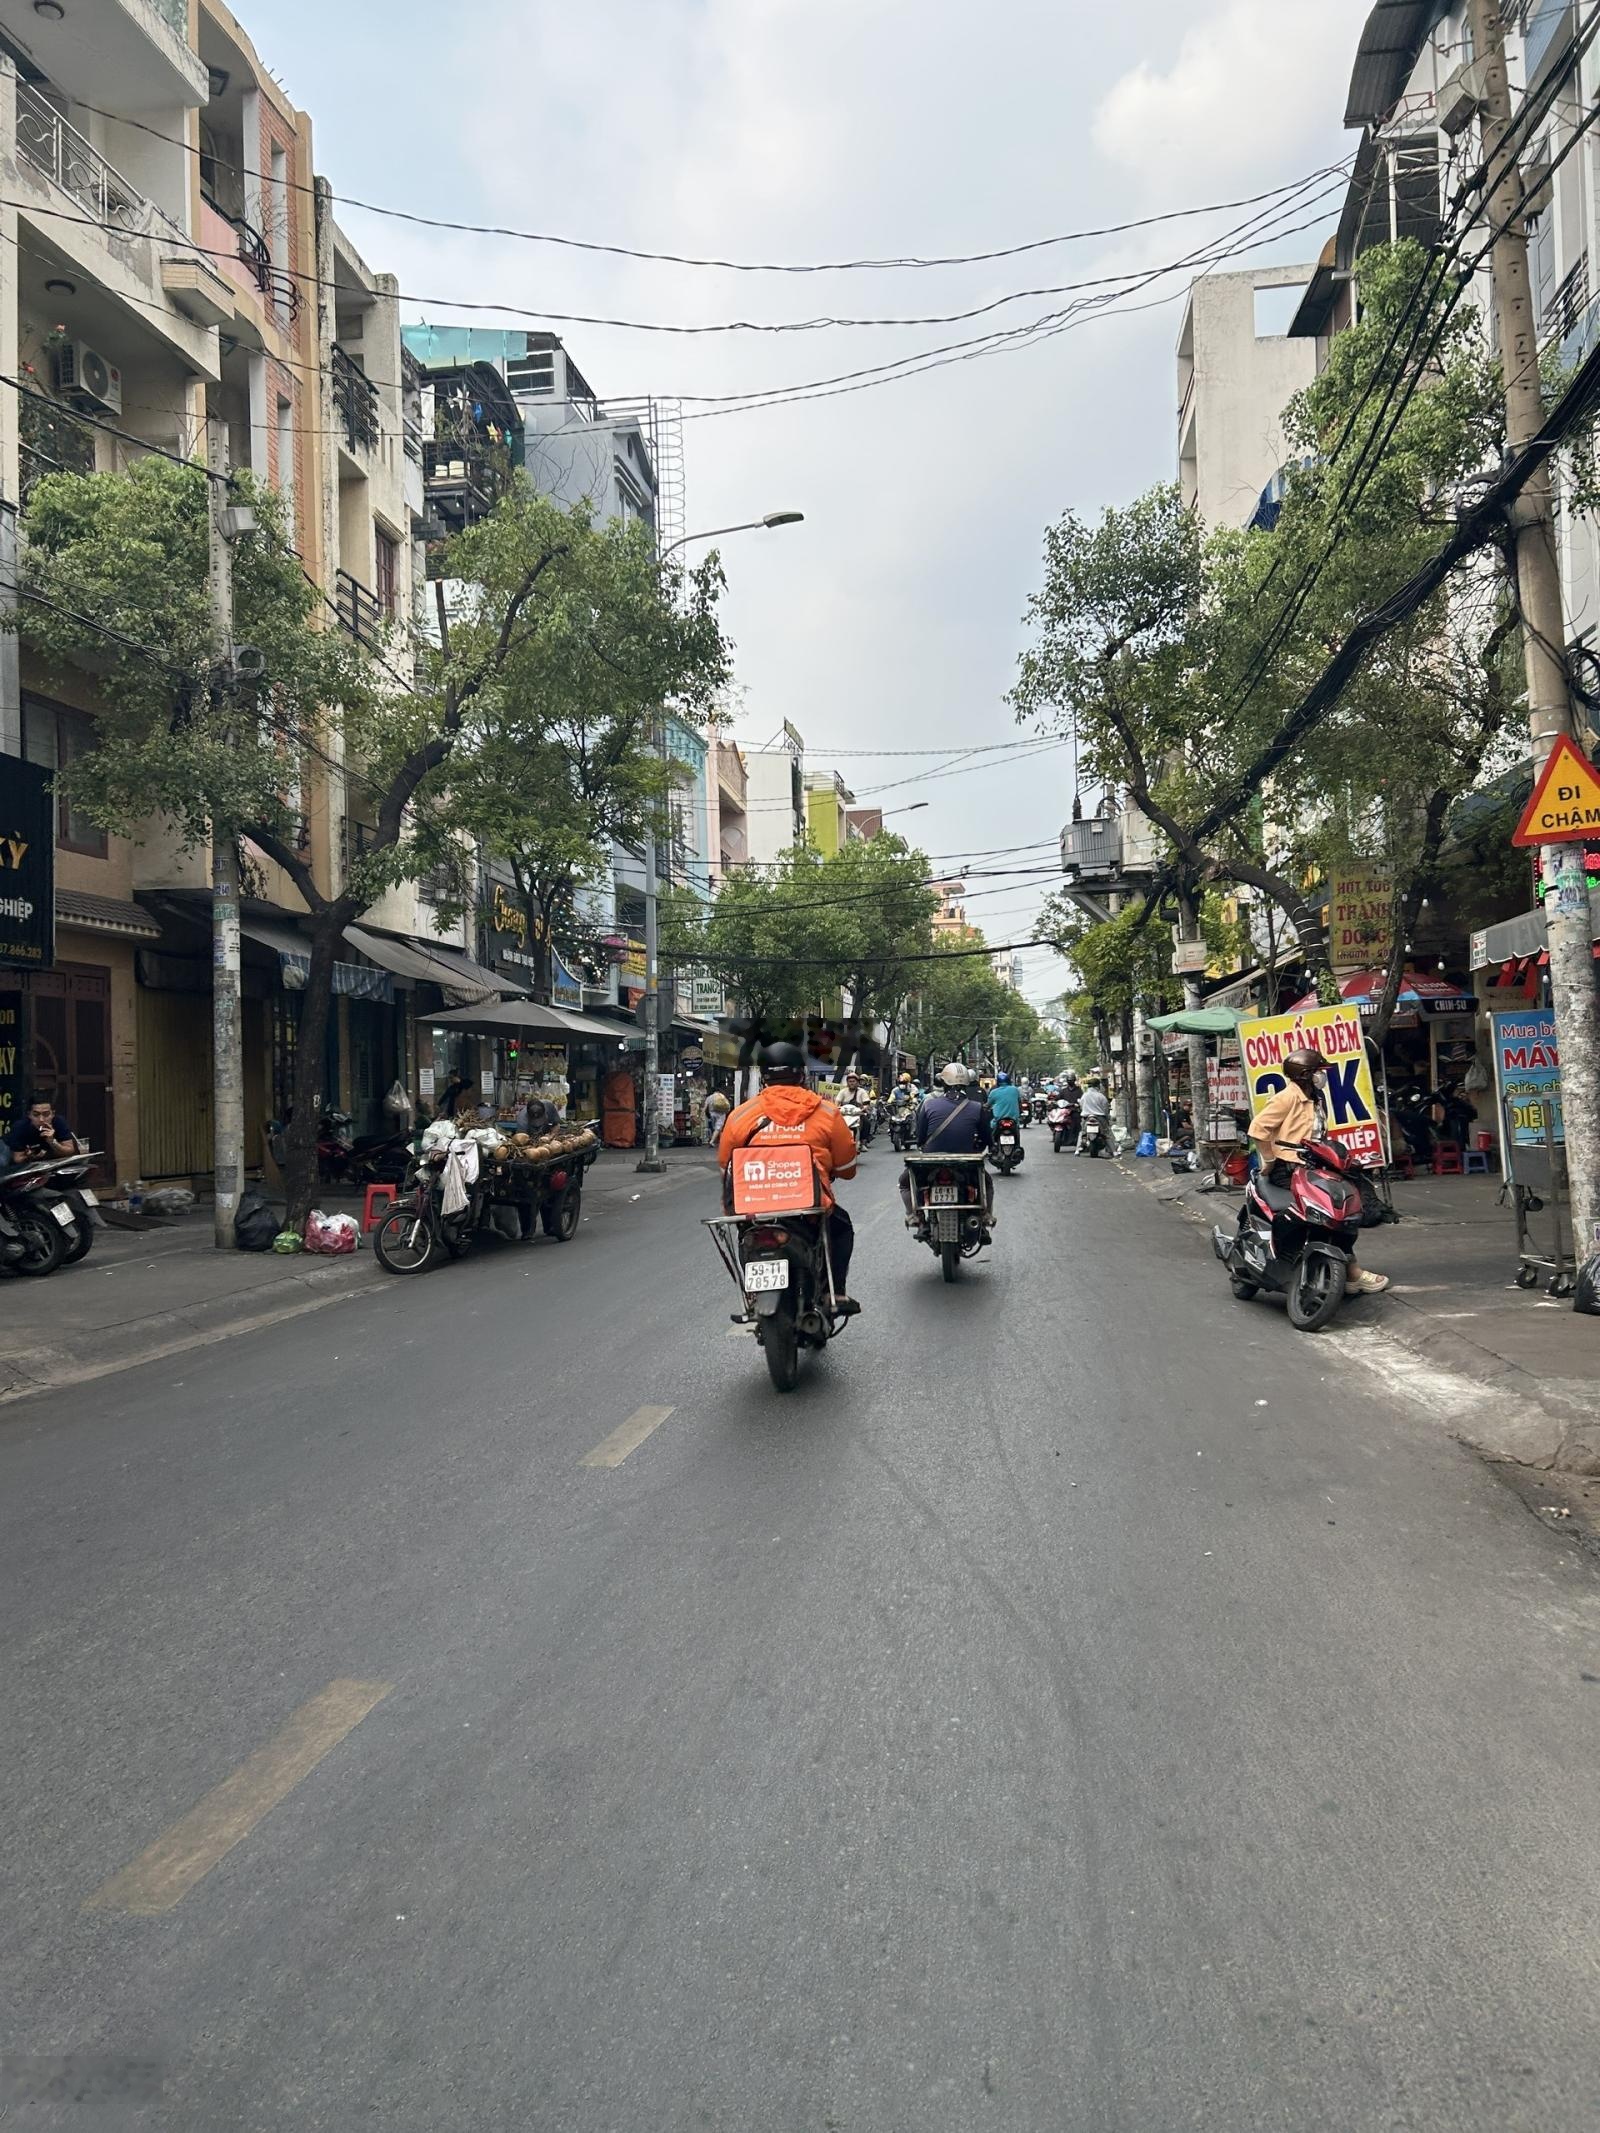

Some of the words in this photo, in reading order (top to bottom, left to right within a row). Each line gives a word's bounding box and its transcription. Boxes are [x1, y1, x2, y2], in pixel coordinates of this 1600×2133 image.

[1558, 785, 1580, 801] ĐI
[1501, 1024, 1536, 1038] Mua
[1246, 1030, 1282, 1067] CƠM
[1322, 1013, 1361, 1054] ĐÊM
[767, 1160, 801, 1169] Shopee
[767, 1168, 802, 1180] Food
[752, 1262, 781, 1276] 59-T1
[748, 1274, 786, 1289] 78578
